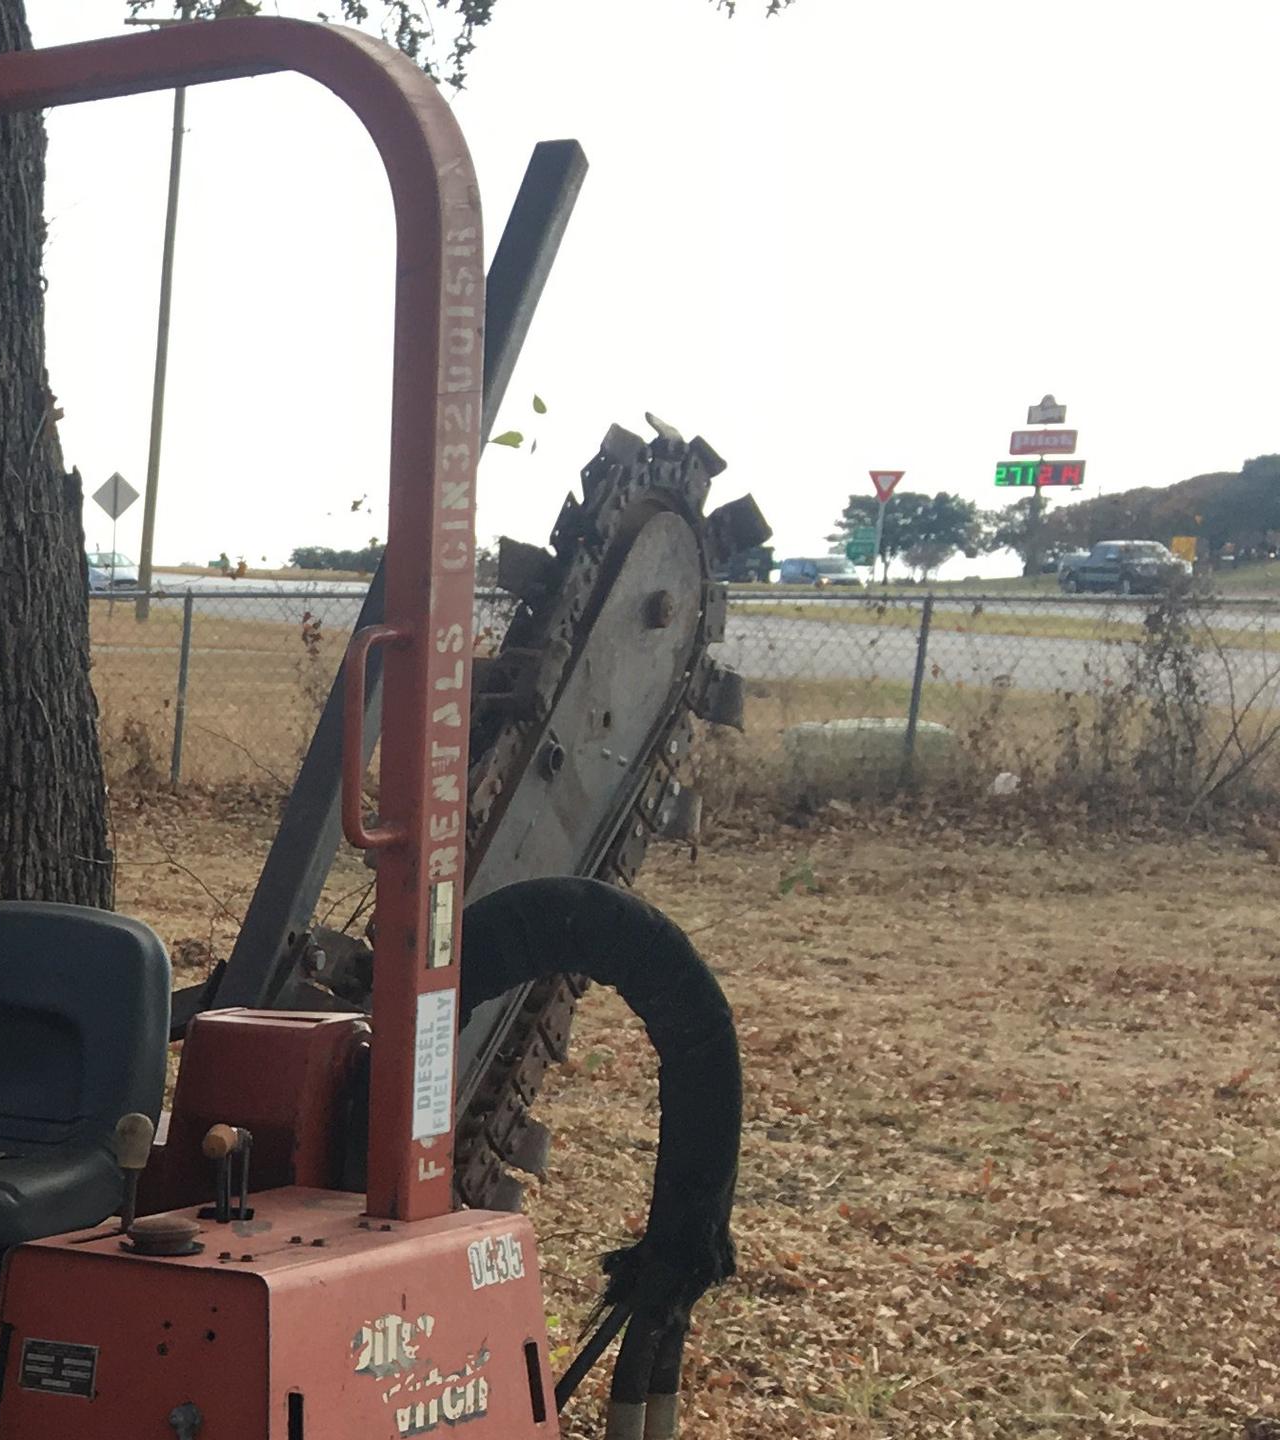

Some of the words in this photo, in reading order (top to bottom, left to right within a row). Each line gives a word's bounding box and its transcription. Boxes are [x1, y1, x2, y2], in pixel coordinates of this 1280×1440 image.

[428, 623, 465, 881] RENTALS
[436, 997, 452, 1058] ONLY
[417, 1021, 434, 1111] DIESEL
[432, 1069, 449, 1129] FUEL
